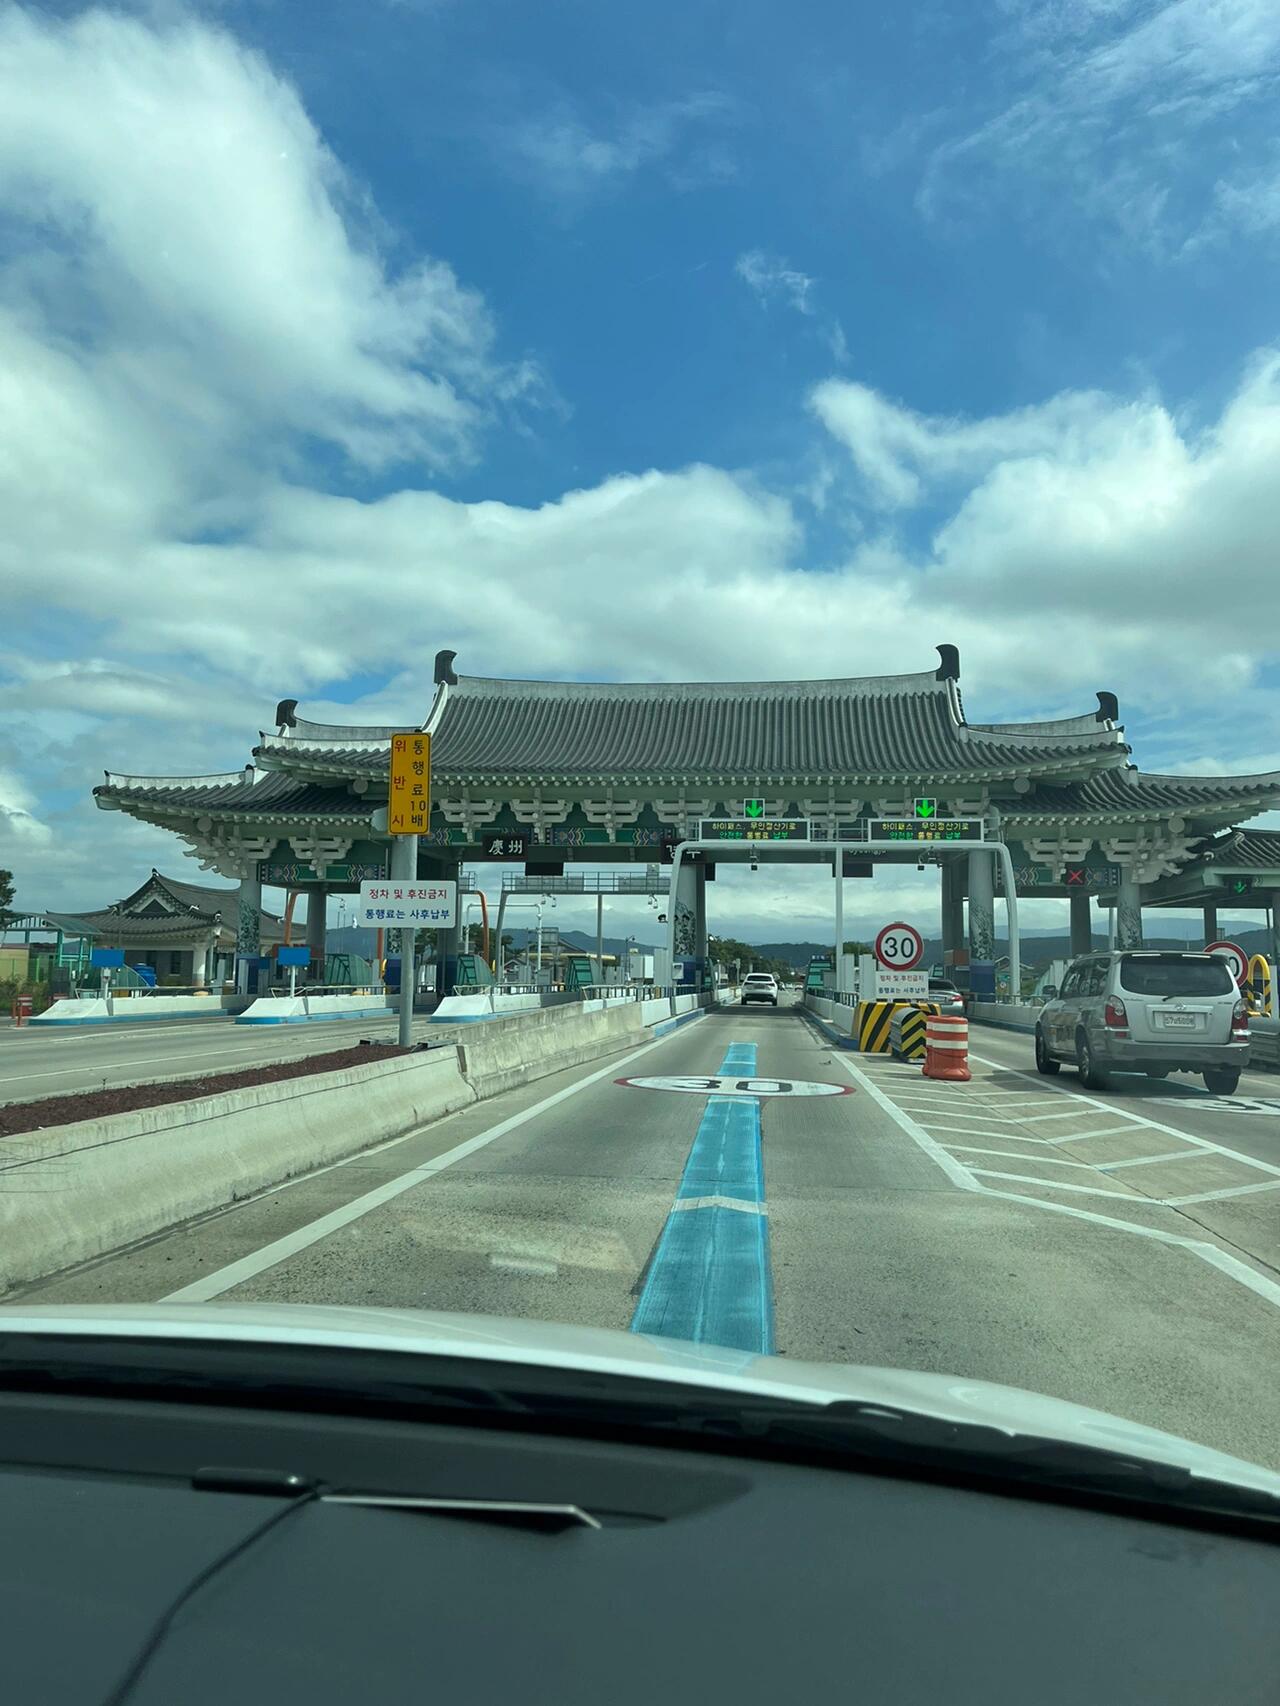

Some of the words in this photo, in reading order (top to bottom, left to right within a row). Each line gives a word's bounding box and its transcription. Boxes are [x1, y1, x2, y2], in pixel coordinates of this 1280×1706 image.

[392, 740, 406, 827] 위반시
[488, 839, 523, 855] 慶州
[369, 889, 389, 900] 정차
[393, 889, 403, 899] 및
[407, 889, 447, 900] 후진금지
[365, 909, 405, 919] 통행료는
[409, 909, 450, 919] 사후납부
[884, 937, 914, 958] 30
[671, 1079, 793, 1092] 30
